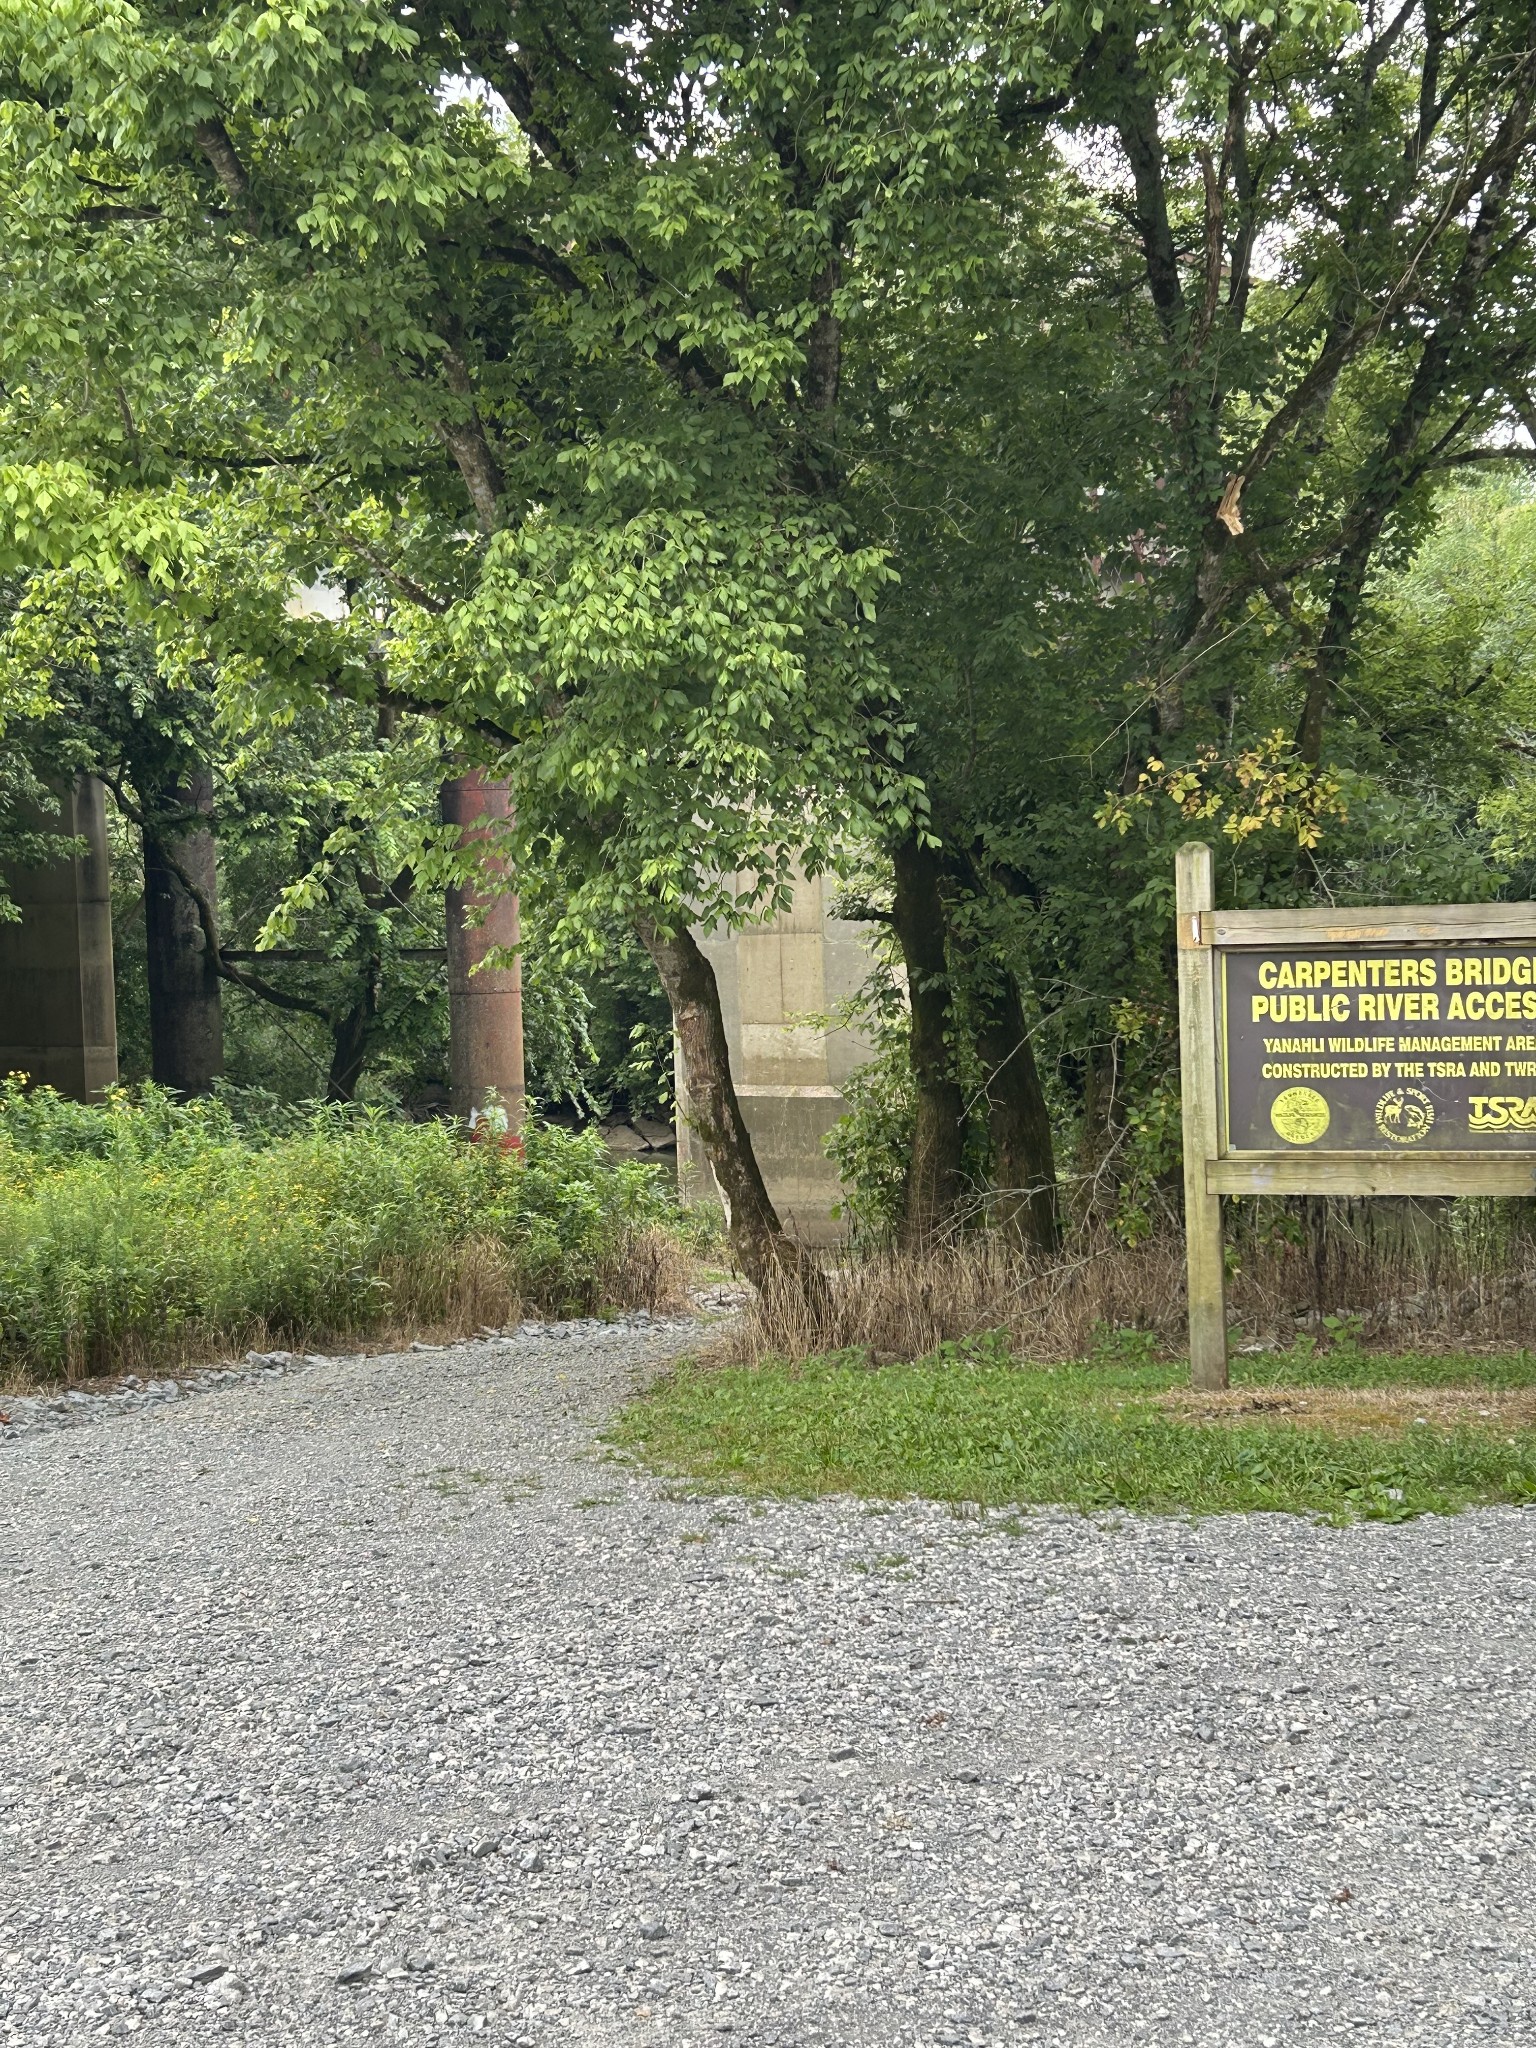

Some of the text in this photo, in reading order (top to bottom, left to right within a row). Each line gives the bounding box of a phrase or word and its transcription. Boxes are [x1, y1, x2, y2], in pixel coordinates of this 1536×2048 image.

[1258, 956, 1536, 989] CARPENTERS BRIDG
[1252, 993, 1351, 1023] PUBLIC
[1358, 992, 1440, 1021] RIVER
[1262, 1037, 1325, 1053] YANAHLI
[1328, 1036, 1396, 1053] WILDLIFE
[1398, 1035, 1503, 1052] MANAGEMENT
[1261, 1063, 1369, 1079] CONSTRUCTED
[1372, 1062, 1392, 1078] BY
[1395, 1062, 1425, 1078] THE
[1427, 1061, 1467, 1078] TSRA
[1469, 1061, 1501, 1077] AND
